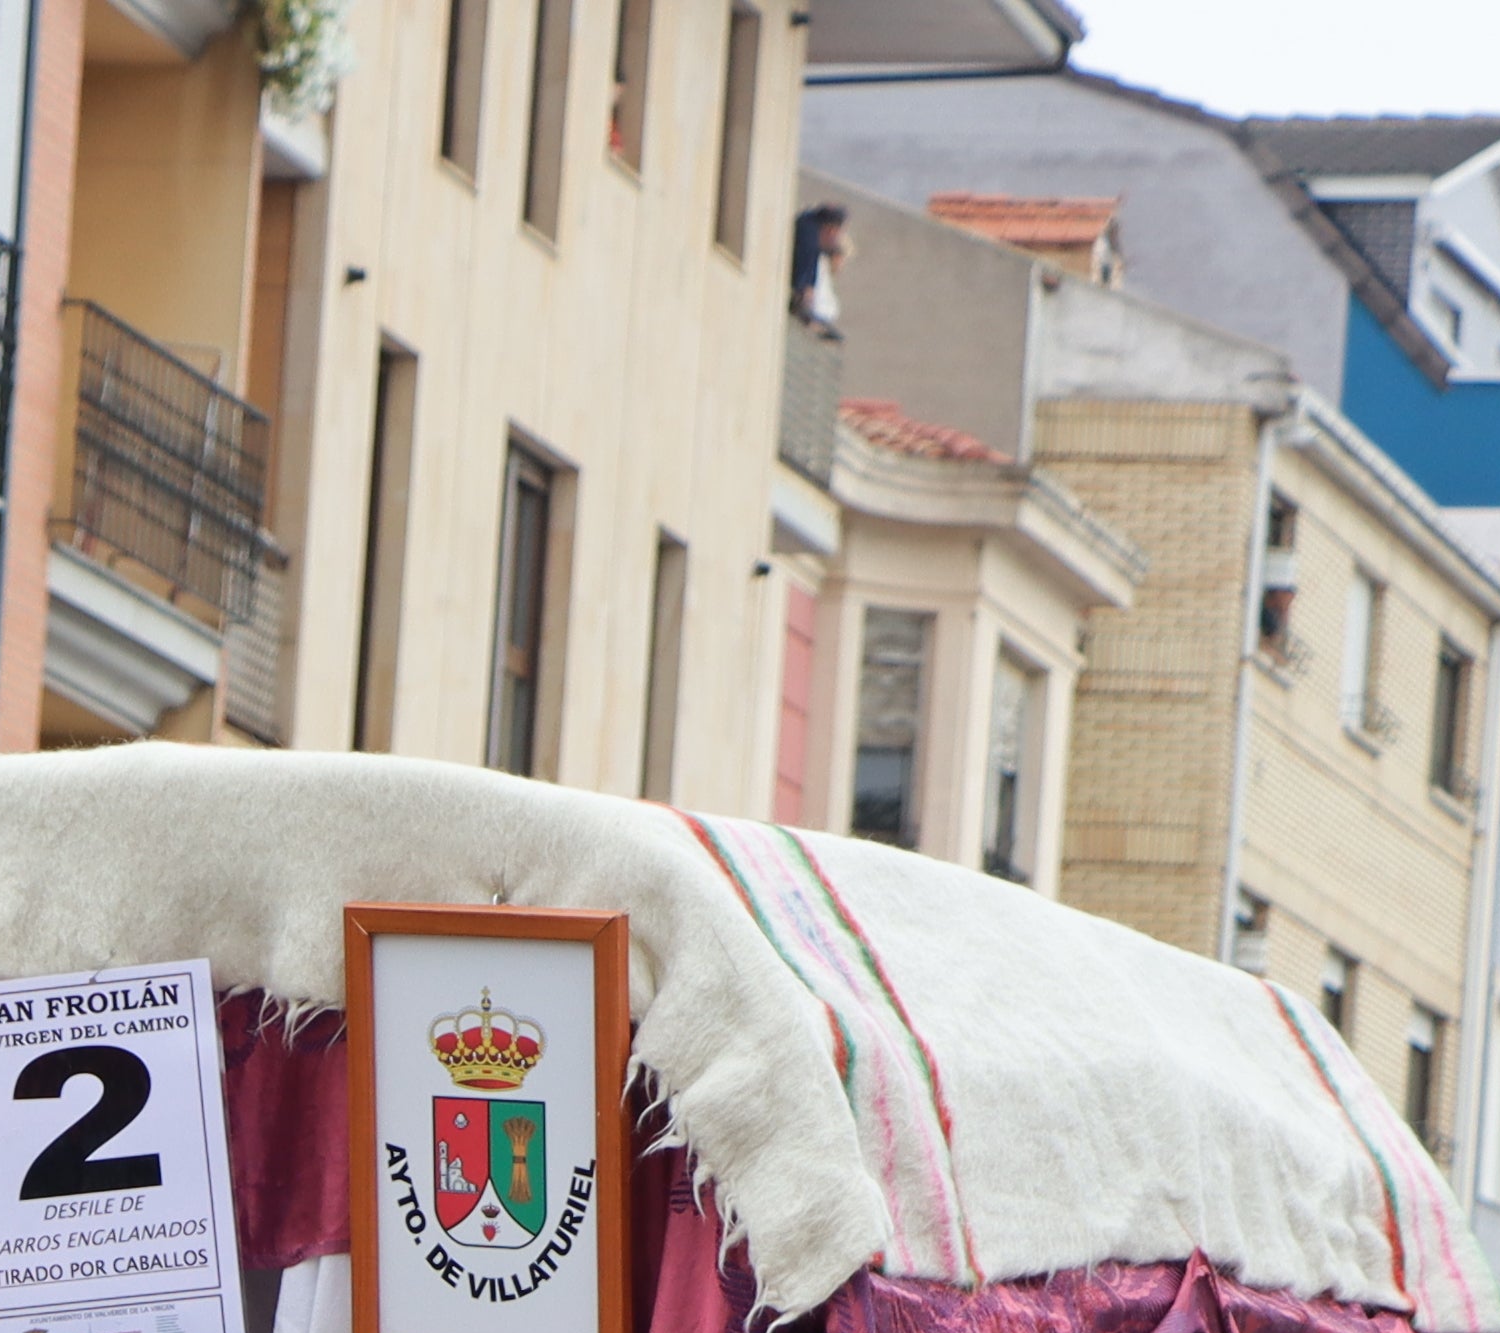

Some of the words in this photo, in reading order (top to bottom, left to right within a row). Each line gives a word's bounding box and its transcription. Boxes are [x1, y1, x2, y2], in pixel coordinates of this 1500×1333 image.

[46, 979, 180, 1019] FROILÁN
[70, 1024, 108, 1040] DEL
[113, 1015, 190, 1035] CAMINO
[13, 1045, 162, 1201] 2
[43, 1201, 114, 1221] DESFILE
[120, 1194, 146, 1212] DE
[385, 1142, 427, 1246] AYTO.
[425, 1243, 465, 1288] DE
[468, 1158, 597, 1303] VILLATURIEL
[67, 1217, 208, 1249] ENGALANADOS
[71, 1259, 107, 1278] POR
[113, 1248, 209, 1274] CABALLOS
